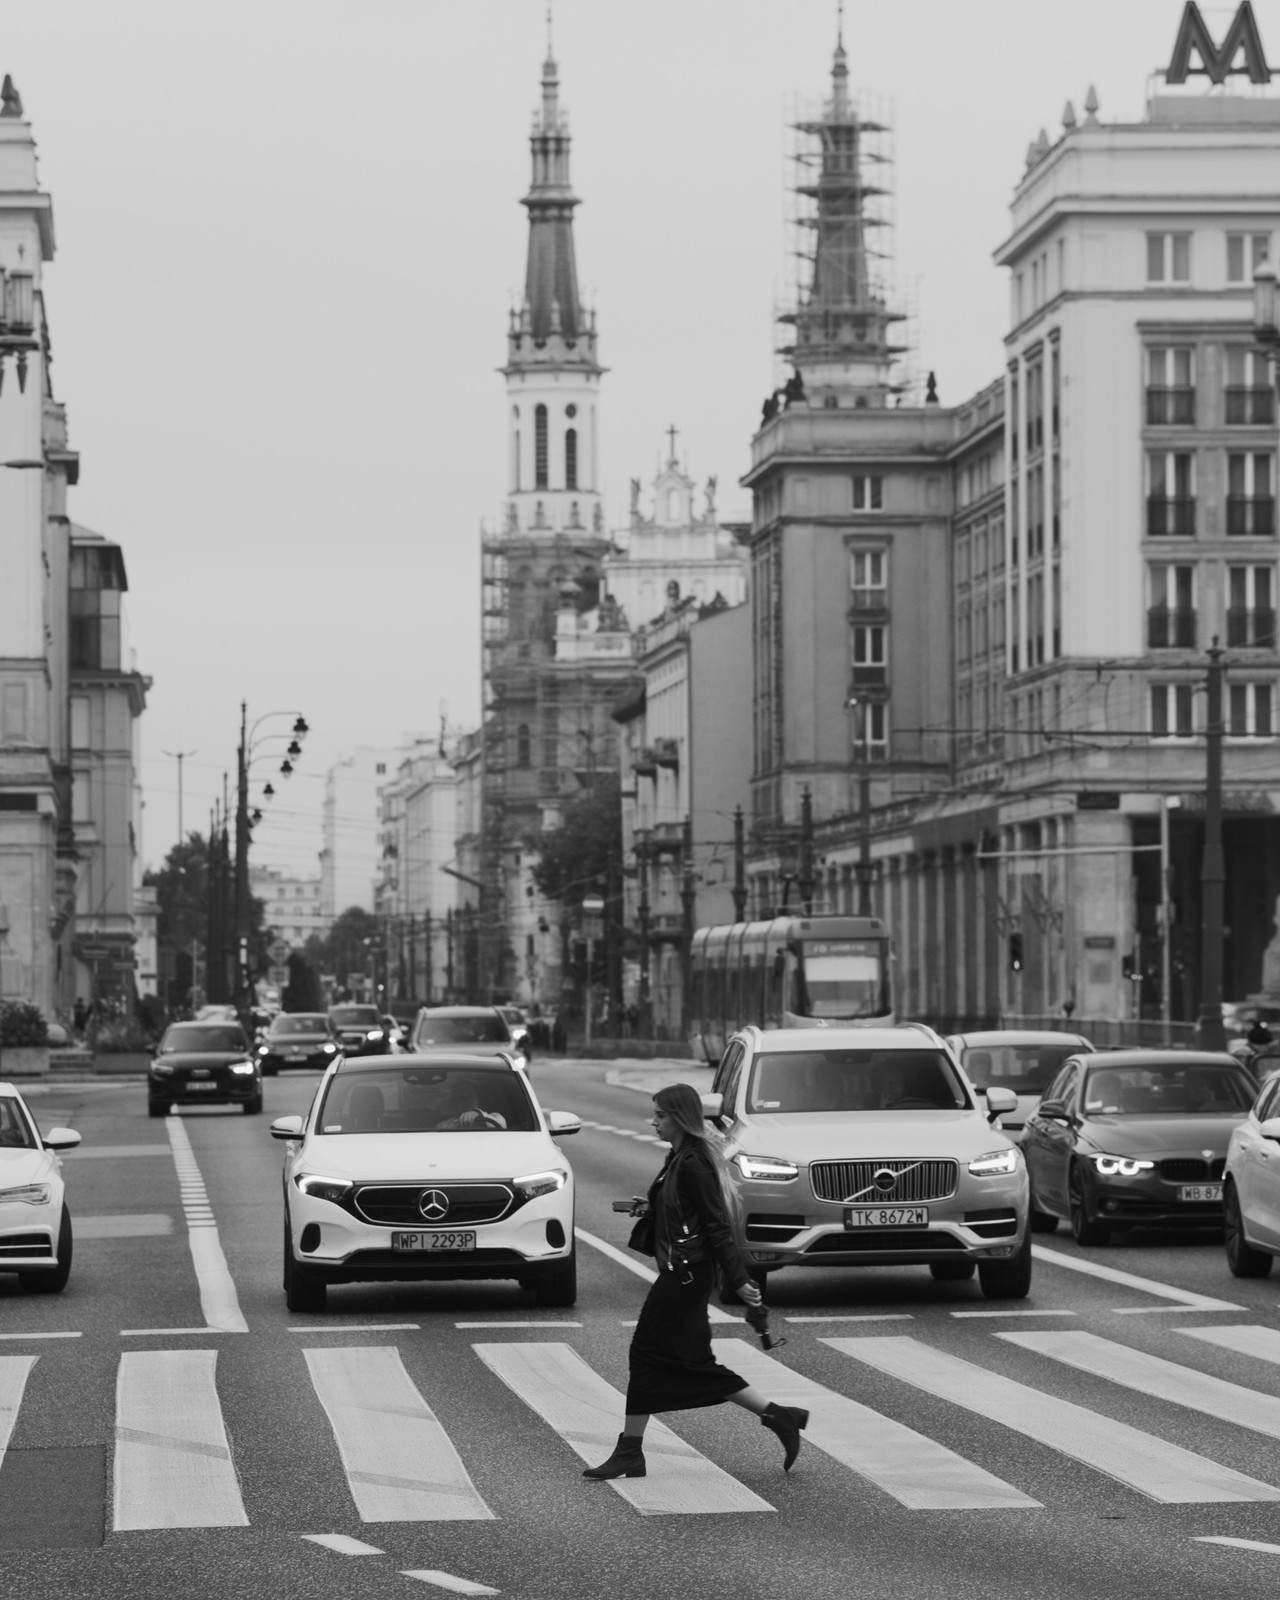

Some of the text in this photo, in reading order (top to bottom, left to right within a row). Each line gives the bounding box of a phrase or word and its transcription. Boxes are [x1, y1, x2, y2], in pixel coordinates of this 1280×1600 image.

[855, 1209, 924, 1225] TK 8672W
[431, 1234, 473, 1248] 2293P
